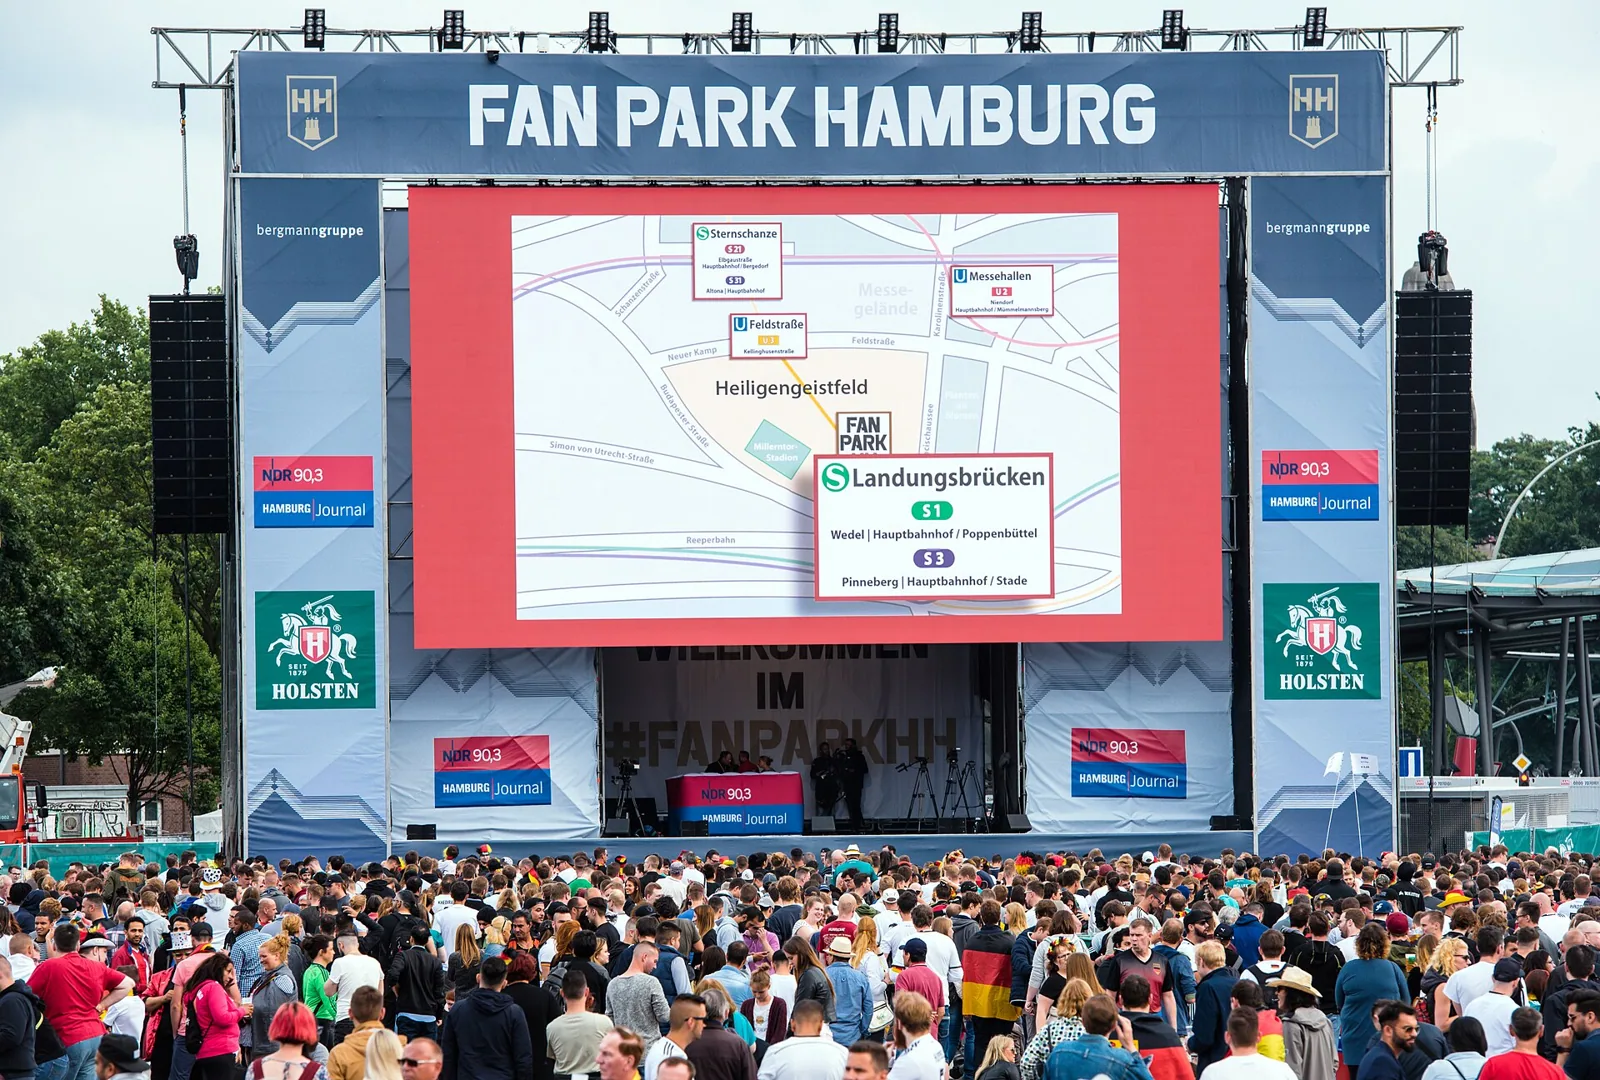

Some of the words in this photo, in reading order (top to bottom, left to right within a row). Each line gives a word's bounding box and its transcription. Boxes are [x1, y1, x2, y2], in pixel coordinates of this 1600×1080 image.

[292, 88, 332, 113] HH
[1294, 87, 1334, 112] HH
[469, 84, 598, 147] FAN
[616, 86, 797, 148] PARK
[814, 84, 1156, 147] HAMBURG
[256, 223, 364, 238] bergmanngruppe
[710, 228, 778, 238] Sternschanze
[1266, 221, 1370, 236] bergmanngruppe
[970, 271, 1032, 281] Messehallen
[615, 270, 660, 317] Schanzenstraße
[933, 271, 946, 337] Karolinenstraße
[750, 319, 804, 329] Feldstraße
[852, 336, 895, 346] Feldstraße
[668, 351, 692, 361] Neuer
[694, 347, 718, 357] Kamp
[716, 379, 868, 399] Heiligengeistfeld
[660, 384, 690, 426] Budapester
[688, 424, 710, 448] Straße
[846, 416, 880, 433] FAN
[840, 434, 887, 451] PARK
[550, 441, 575, 451] Simon
[594, 448, 655, 464] Utrecht-Straße
[262, 468, 292, 482] NDR
[294, 468, 323, 484] 90,3
[1270, 462, 1298, 476] NDR
[1300, 462, 1330, 478] 90,3
[853, 466, 1045, 492] Landungsbrücken
[262, 504, 311, 514] HAMBURG
[315, 503, 366, 517] Journal
[1270, 497, 1318, 507] HAMBURG
[1322, 496, 1371, 510] Journal
[686, 536, 736, 545] Reeperbahn
[831, 530, 865, 540] Wedel
[873, 529, 954, 541] Hauptbahnhof
[962, 528, 1037, 540] Poppenbüttel
[842, 577, 899, 589] Pinneberg
[907, 576, 988, 588] Hauptbahnhof
[996, 575, 1028, 586] Stade
[1280, 674, 1365, 690] HOLSTEN
[272, 683, 359, 700] HOLSTEN
[756, 672, 804, 710] IM
[442, 748, 471, 764] NDR
[473, 748, 502, 764] 90,3
[1079, 740, 1108, 754] NDR
[1110, 740, 1138, 756] 90,3
[443, 783, 490, 793] HAMBURG
[494, 781, 543, 796] Journal
[1080, 774, 1126, 783] HAMBURG
[1130, 775, 1179, 788] Journal
[702, 788, 726, 800] NDR
[727, 788, 752, 802] 90,3
[702, 813, 742, 823] HAMBURG
[745, 812, 787, 825] Journal
